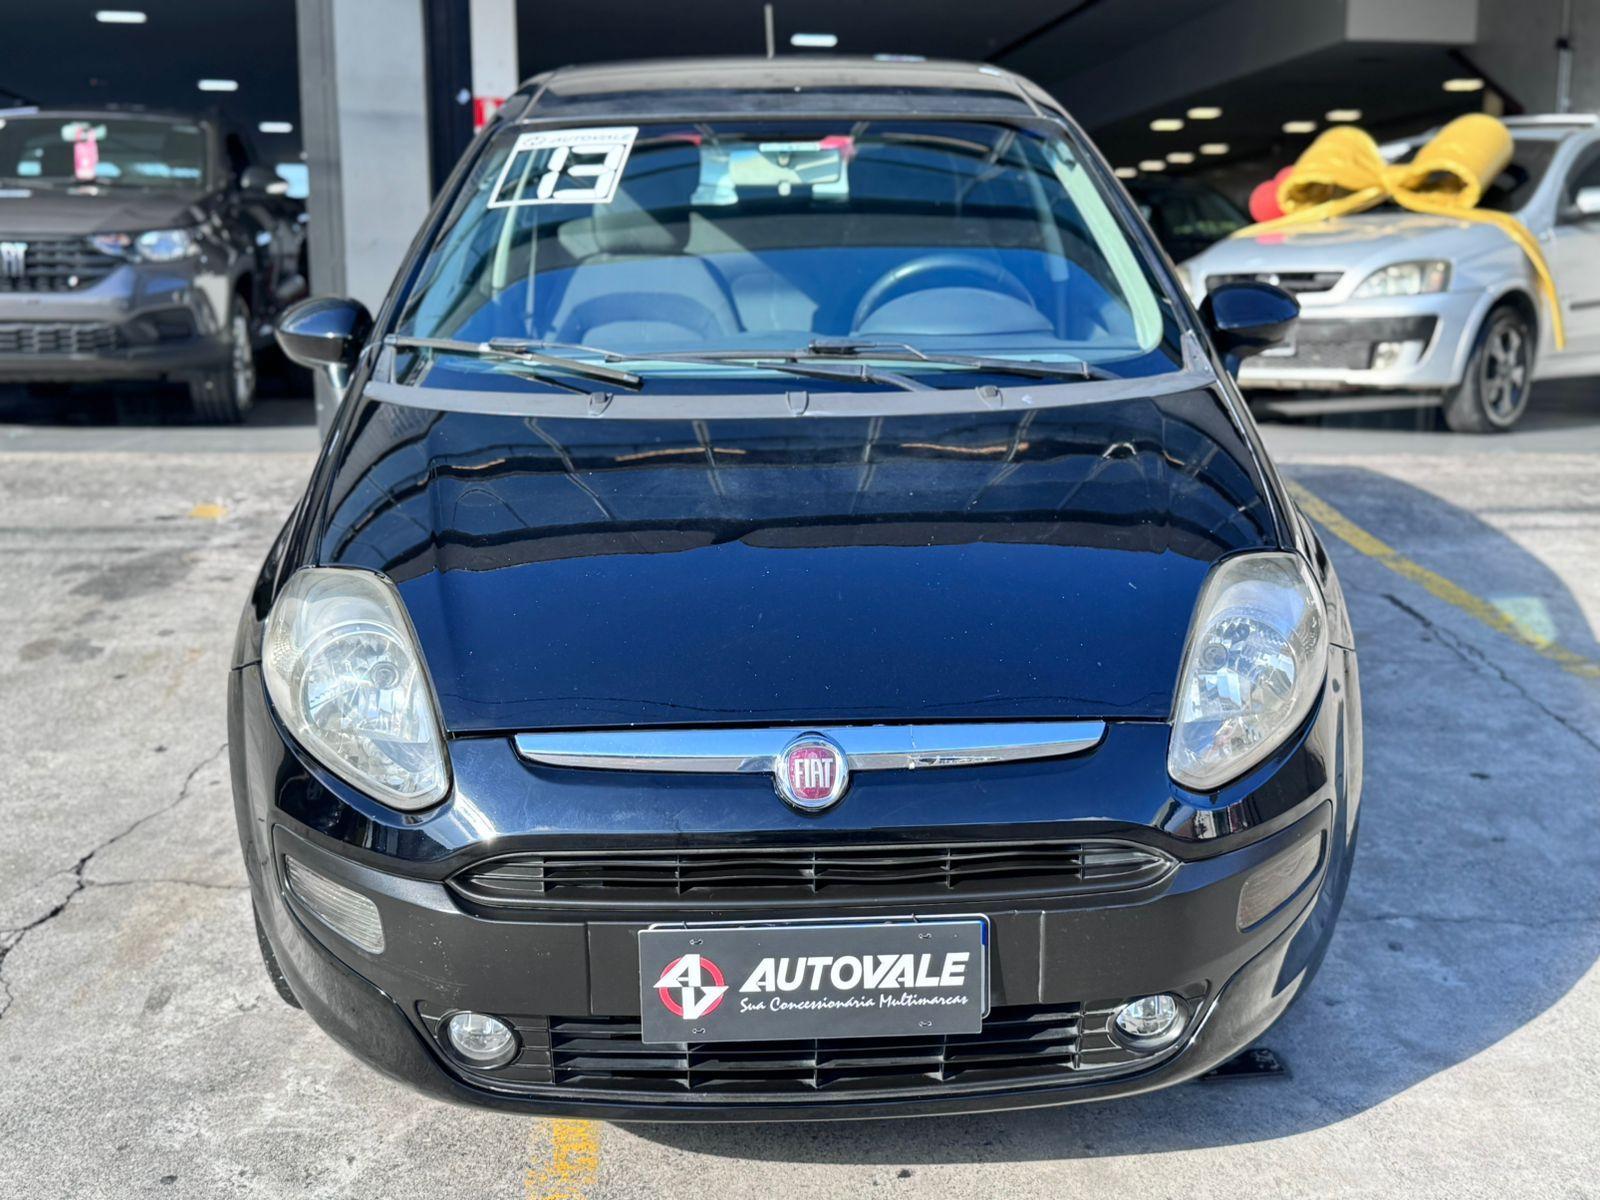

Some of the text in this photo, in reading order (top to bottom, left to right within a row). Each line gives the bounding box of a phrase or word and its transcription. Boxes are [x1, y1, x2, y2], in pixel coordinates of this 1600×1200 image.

[537, 144, 626, 201] 13
[794, 757, 834, 789] FIAT
[738, 952, 970, 993] AUTOVALE
[739, 991, 969, 1013] Sua Concessionária Multimarcas
